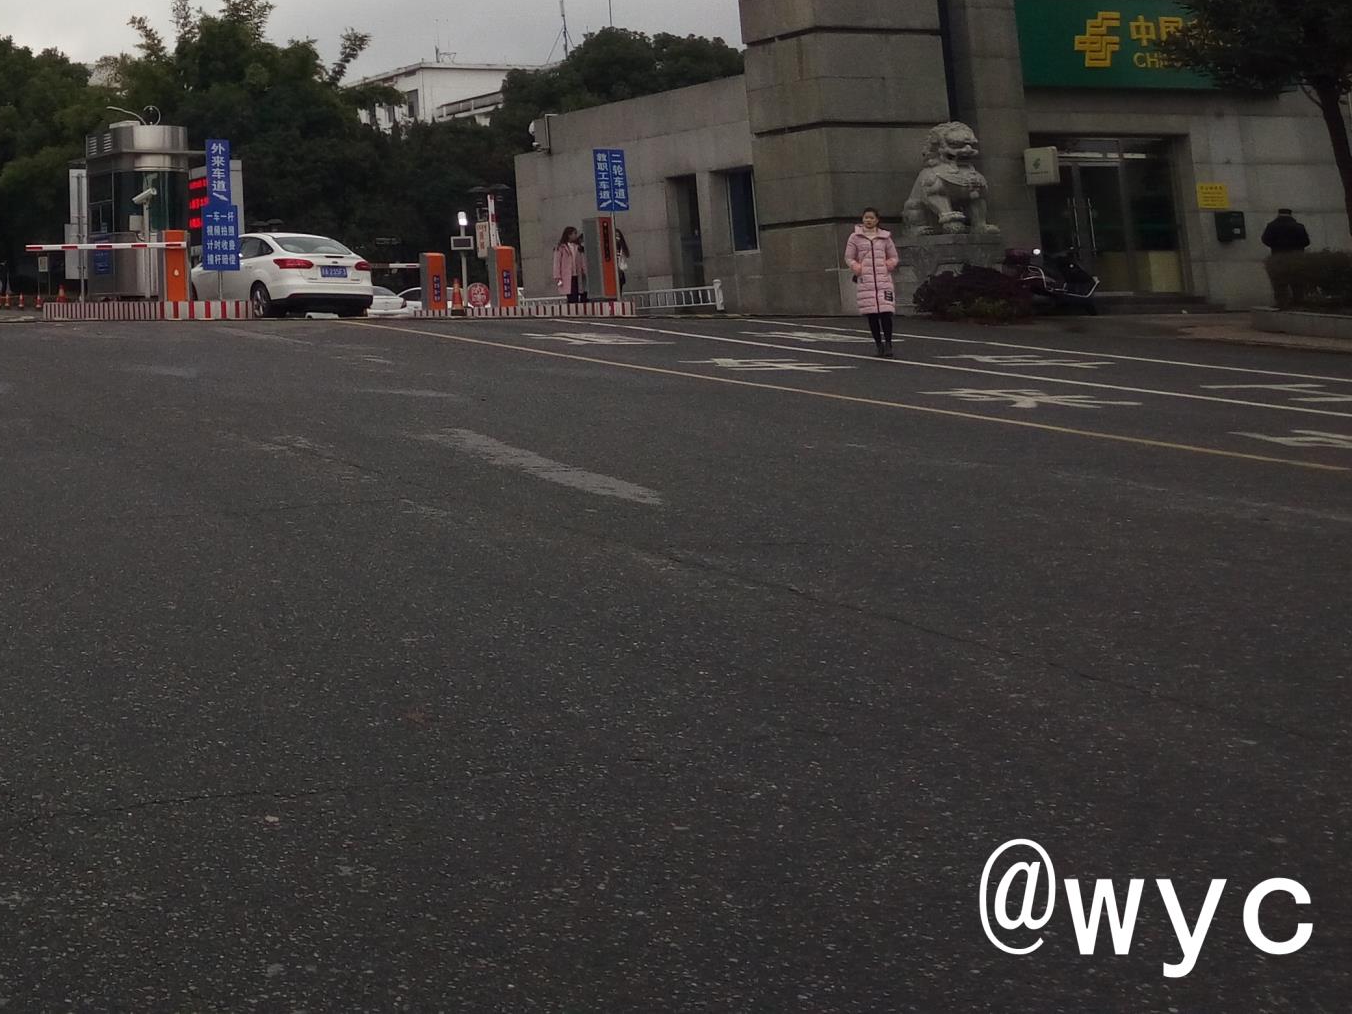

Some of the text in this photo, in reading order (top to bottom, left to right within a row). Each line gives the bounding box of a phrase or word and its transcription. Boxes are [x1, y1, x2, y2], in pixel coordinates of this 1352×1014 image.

[212, 143, 226, 192] 外来车道
[611, 153, 625, 199] 二轮车道
[206, 211, 235, 222] 一车一杆
[206, 240, 236, 251] 计时收费
